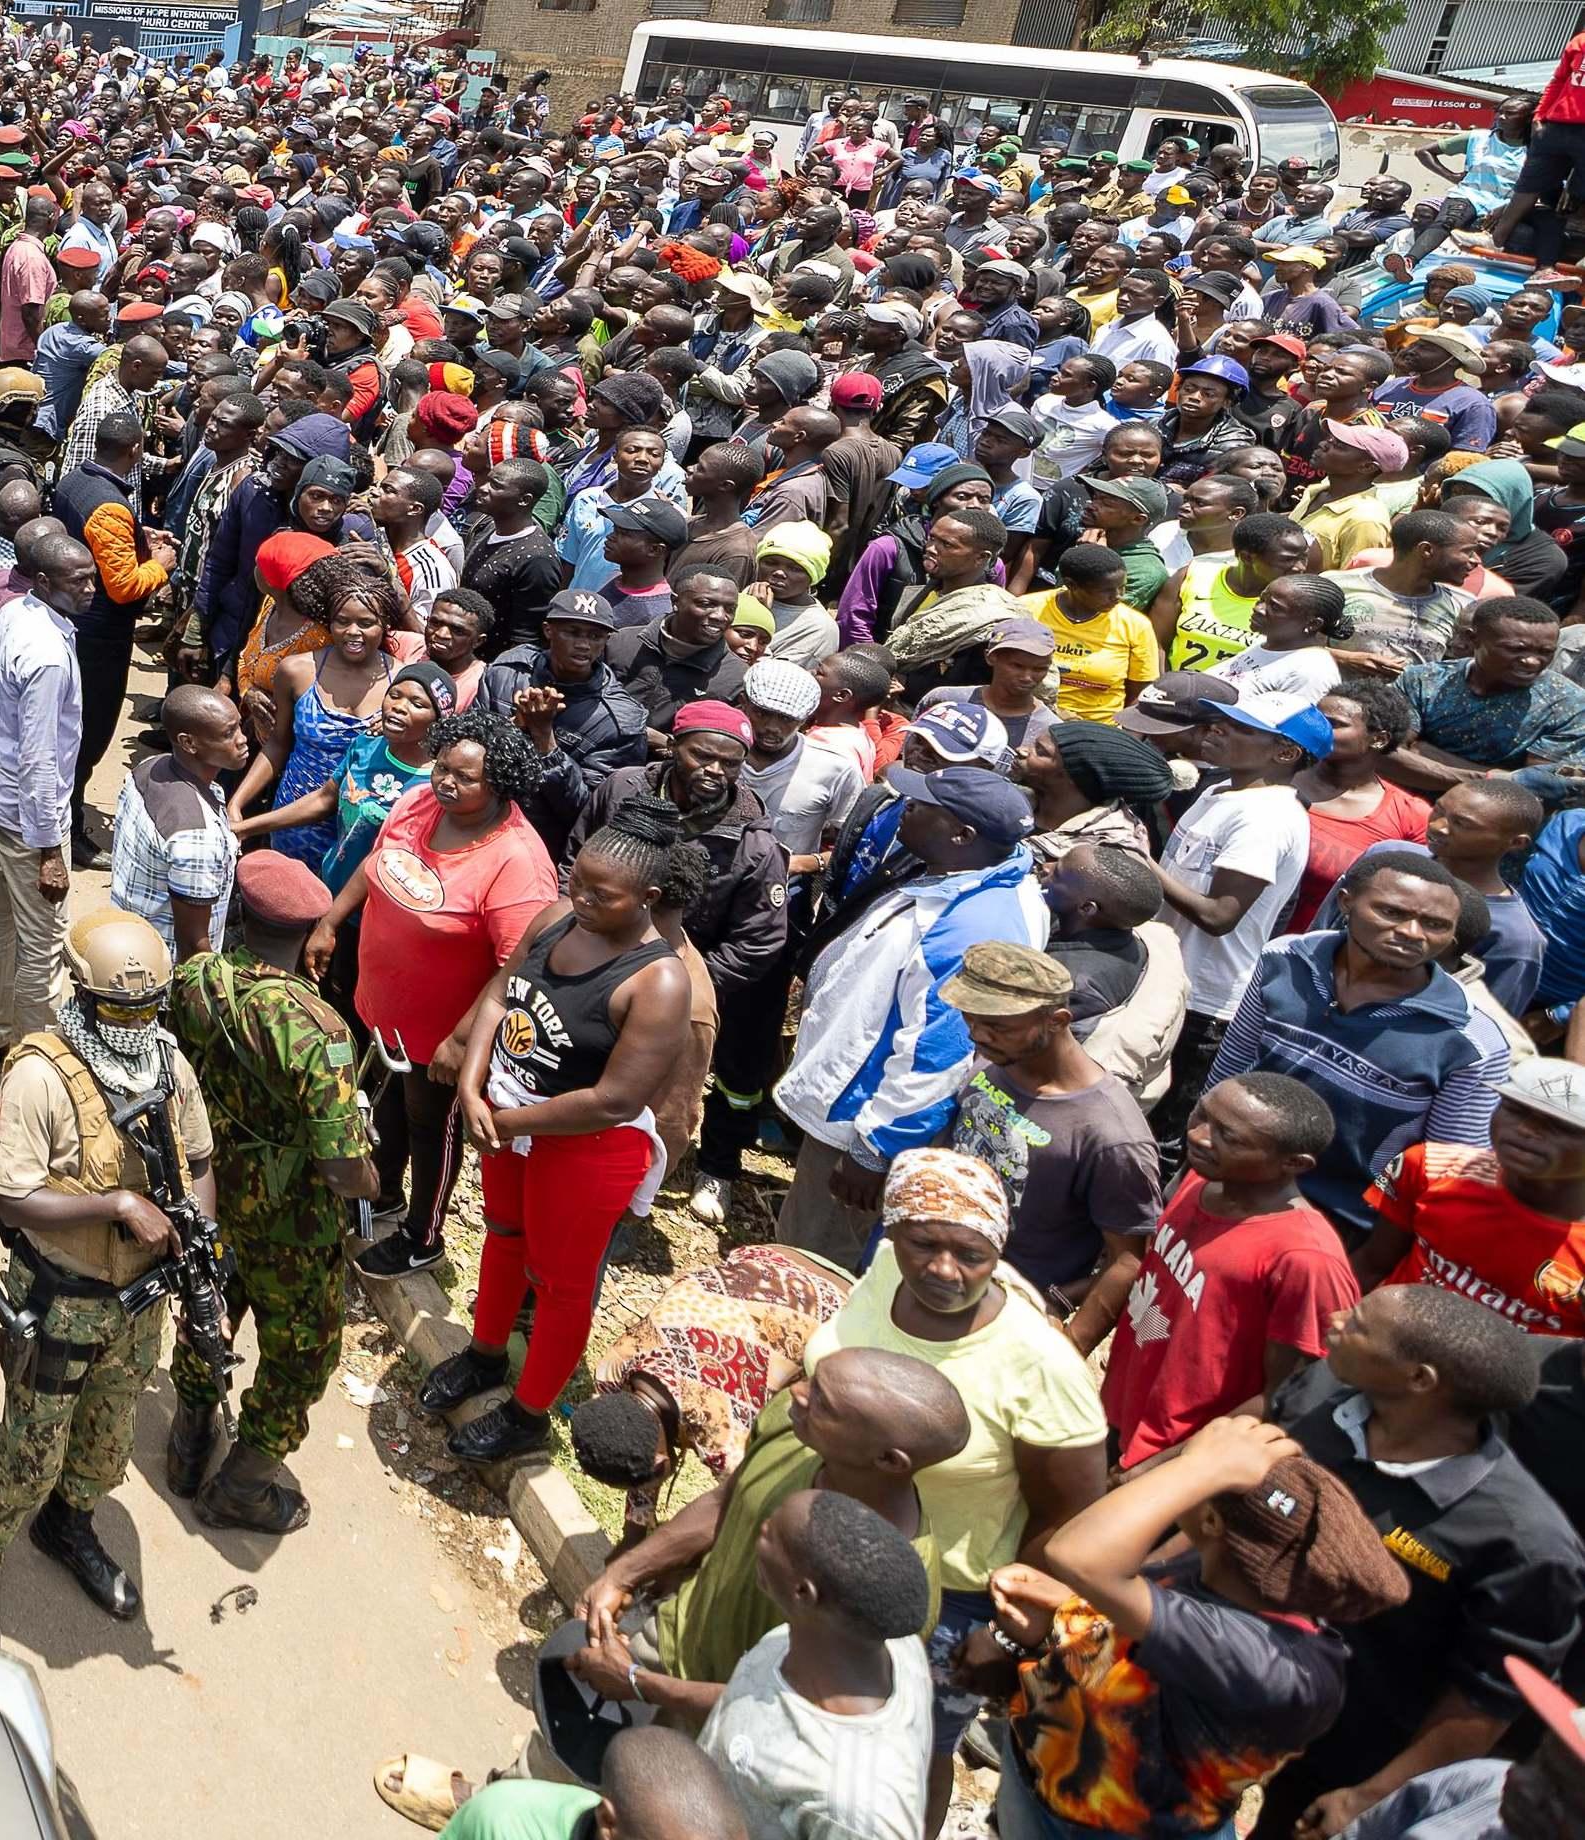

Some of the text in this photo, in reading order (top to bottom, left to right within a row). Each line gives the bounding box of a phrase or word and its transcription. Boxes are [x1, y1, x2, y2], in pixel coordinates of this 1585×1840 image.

[94, 5, 235, 20] MISSIONS OF HOPE INTERNATIONAL
[170, 19, 210, 30] CENTRE
[1433, 100, 1466, 109] LESSON
[506, 975, 532, 1002] EW
[531, 990, 573, 1048] YORK
[1154, 1223, 1206, 1314] NADA
